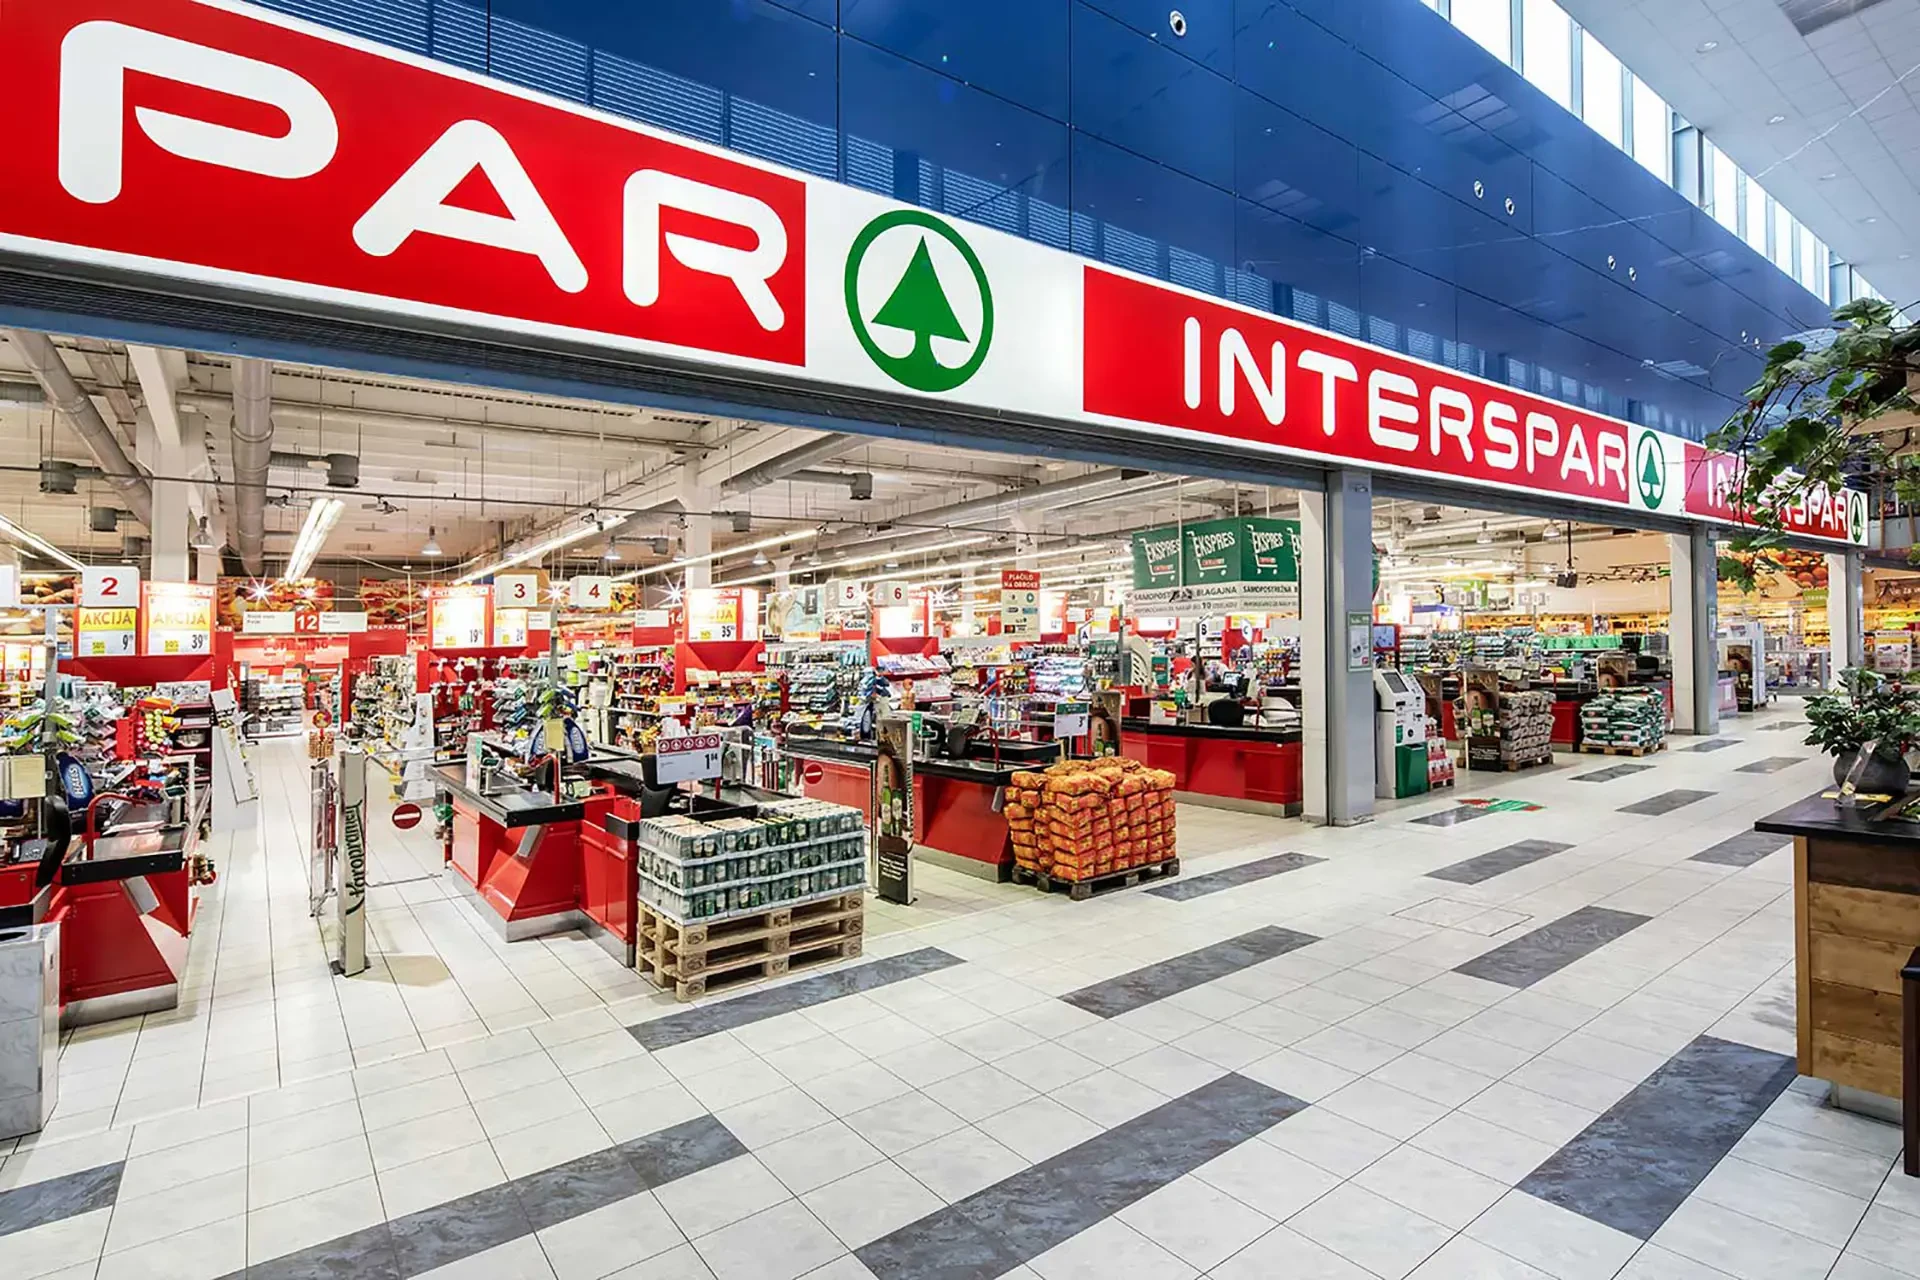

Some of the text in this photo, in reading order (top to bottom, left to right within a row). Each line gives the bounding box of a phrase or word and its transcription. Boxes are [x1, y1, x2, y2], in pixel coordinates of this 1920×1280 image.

[59, 20, 788, 333] PAR
[1184, 316, 1628, 491] INTERSPAR
[1193, 532, 1235, 557] EKSPRES
[1252, 532, 1283, 553] EKSPRES
[101, 577, 118, 595] 2
[514, 583, 525, 599] 3
[589, 584, 600, 599] 4
[846, 587, 854, 599] 5
[1196, 586, 1237, 597] BLAGAJNA
[894, 588, 902, 599] 6
[83, 611, 132, 625] AKCIJA
[154, 612, 206, 624] AKCIJA
[296, 615, 318, 630] 12
[669, 612, 683, 624] 14
[1082, 631, 1088, 639] A
[1201, 623, 1207, 635] B
